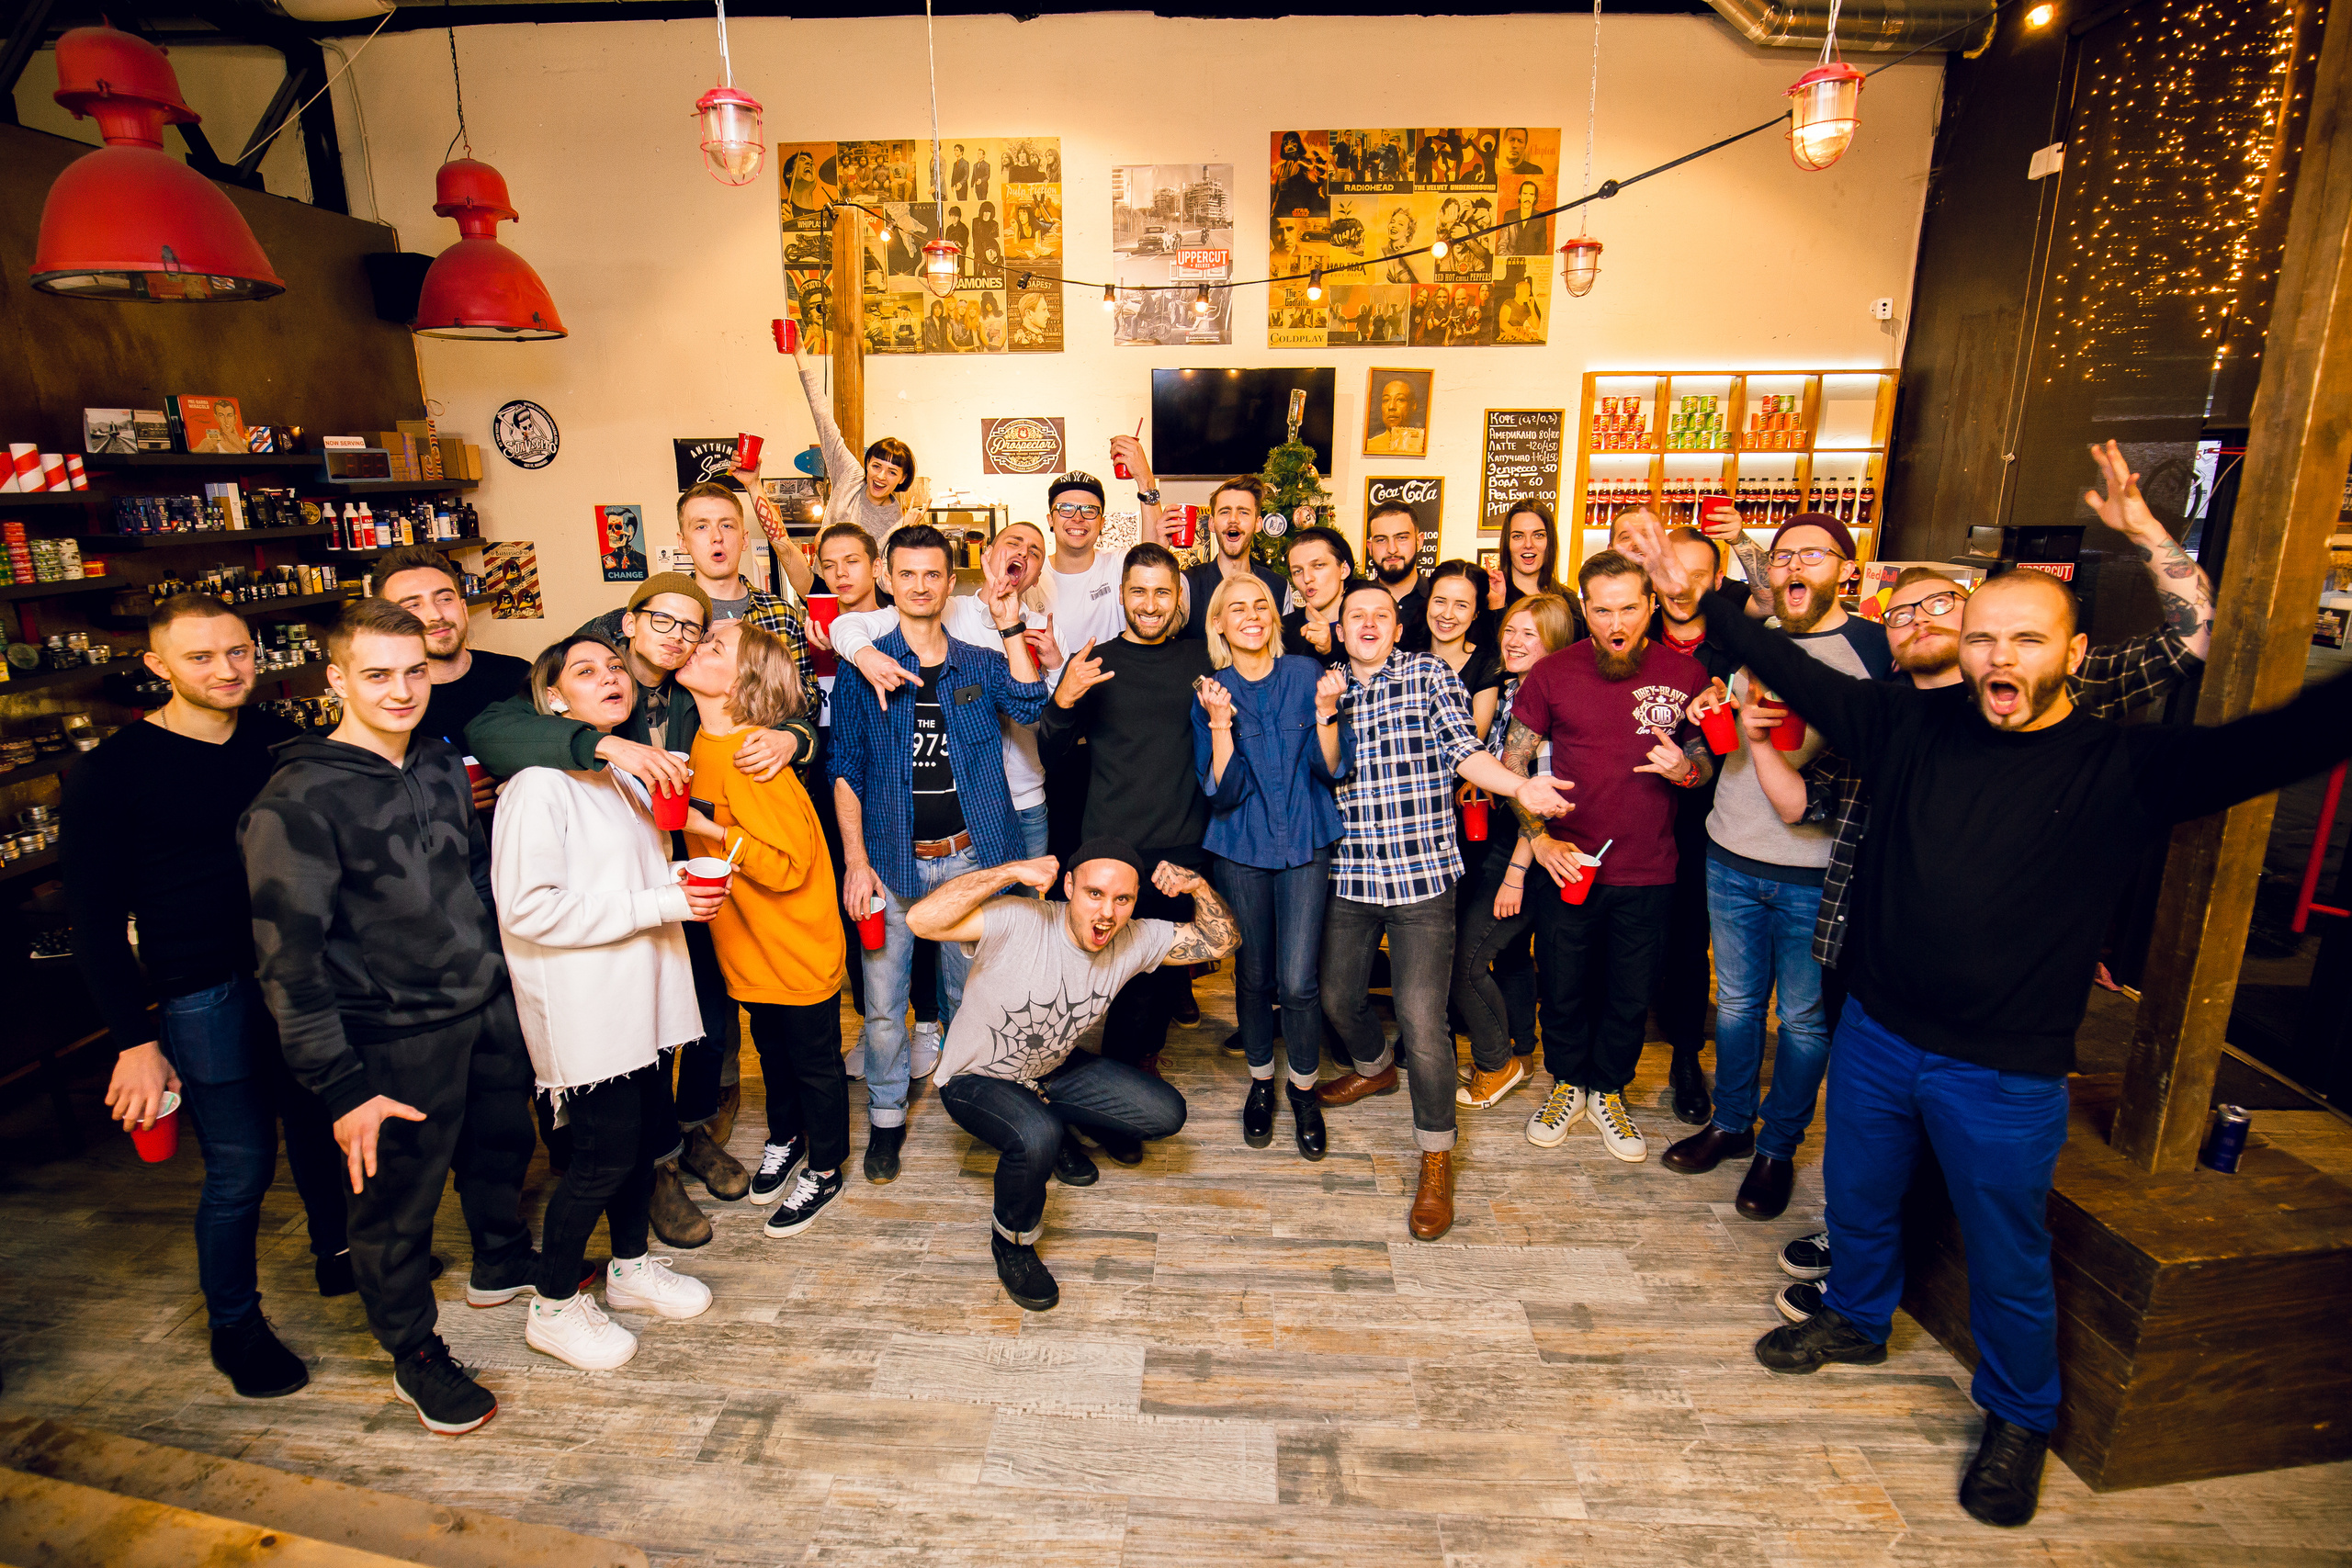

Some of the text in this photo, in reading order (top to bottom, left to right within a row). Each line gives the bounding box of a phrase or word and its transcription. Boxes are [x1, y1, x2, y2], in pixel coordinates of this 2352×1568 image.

[1530, 145, 1556, 159] Clapton
[1005, 184, 1057, 198] Pulp Fiction
[1344, 184, 1395, 192] RADIOHEAD
[1177, 250, 1228, 265] UPPERCUT
[956, 277, 1003, 289] AMONES
[1434, 272, 1492, 282] RED HOT CHILI PEPPERS
[1285, 288, 1297, 298] The
[1270, 333, 1325, 344] COLDPLAY
[690, 443, 733, 458] ANYTHIN
[989, 436, 1057, 454] Prospectors
[1487, 502, 1516, 517] Prin
[1865, 568, 1898, 583] Red Bull
[917, 719, 936, 728] THE
[912, 732, 950, 758] 975
